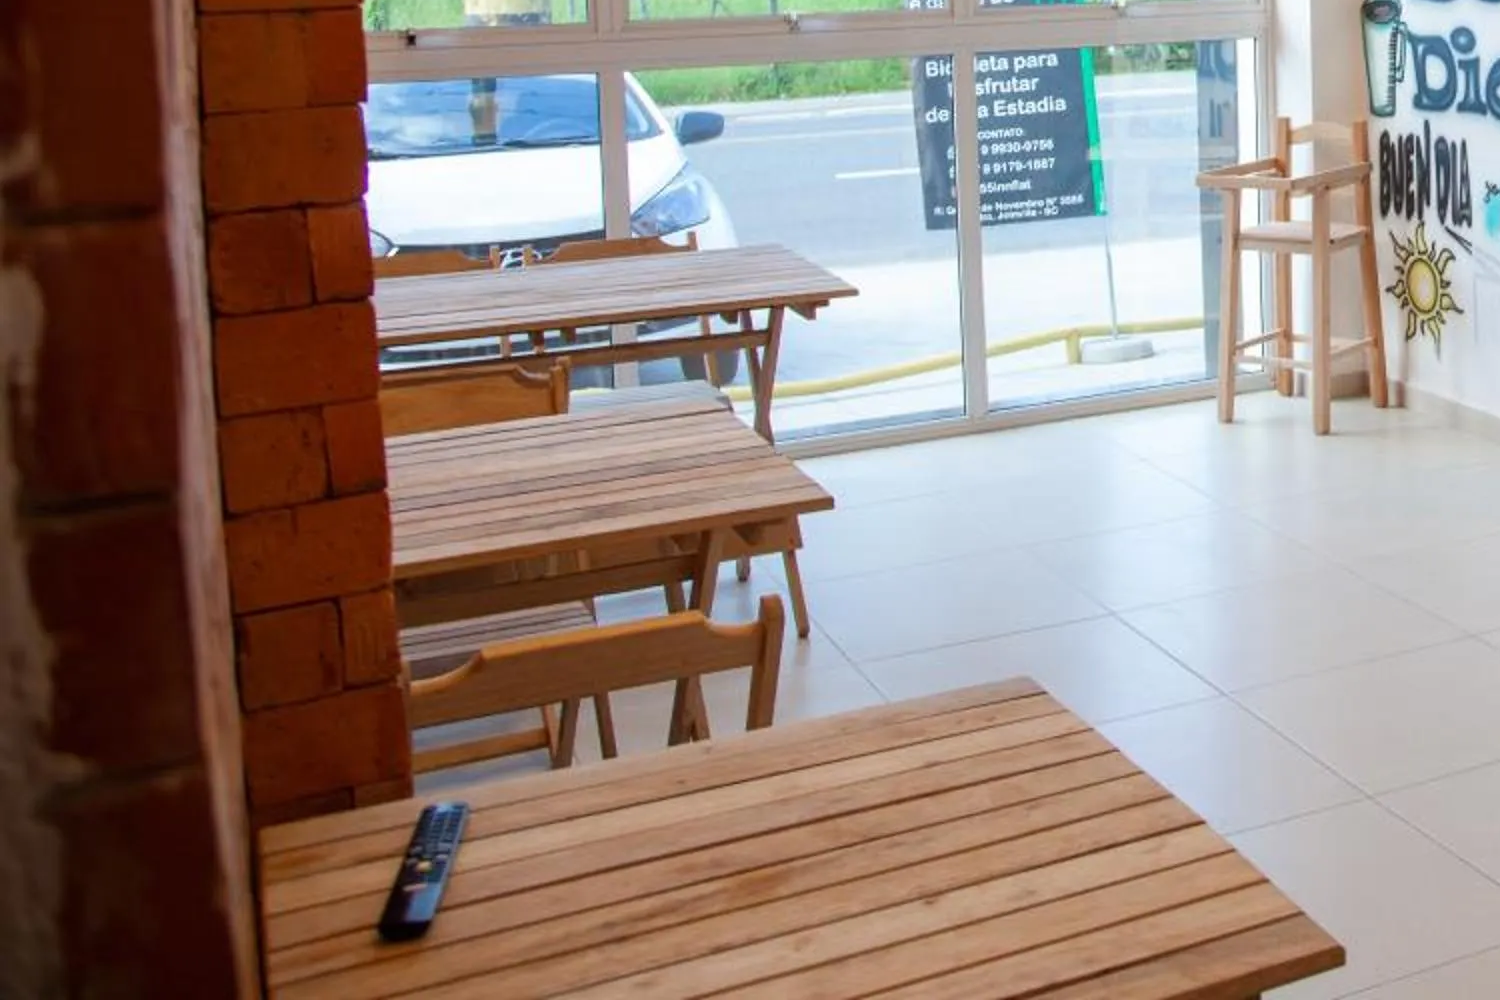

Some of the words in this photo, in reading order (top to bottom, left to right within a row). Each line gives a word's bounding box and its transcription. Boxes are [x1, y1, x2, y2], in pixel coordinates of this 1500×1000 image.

[1013, 53, 1058, 73] para
[925, 106, 950, 124] de
[993, 95, 1068, 118] Estadia
